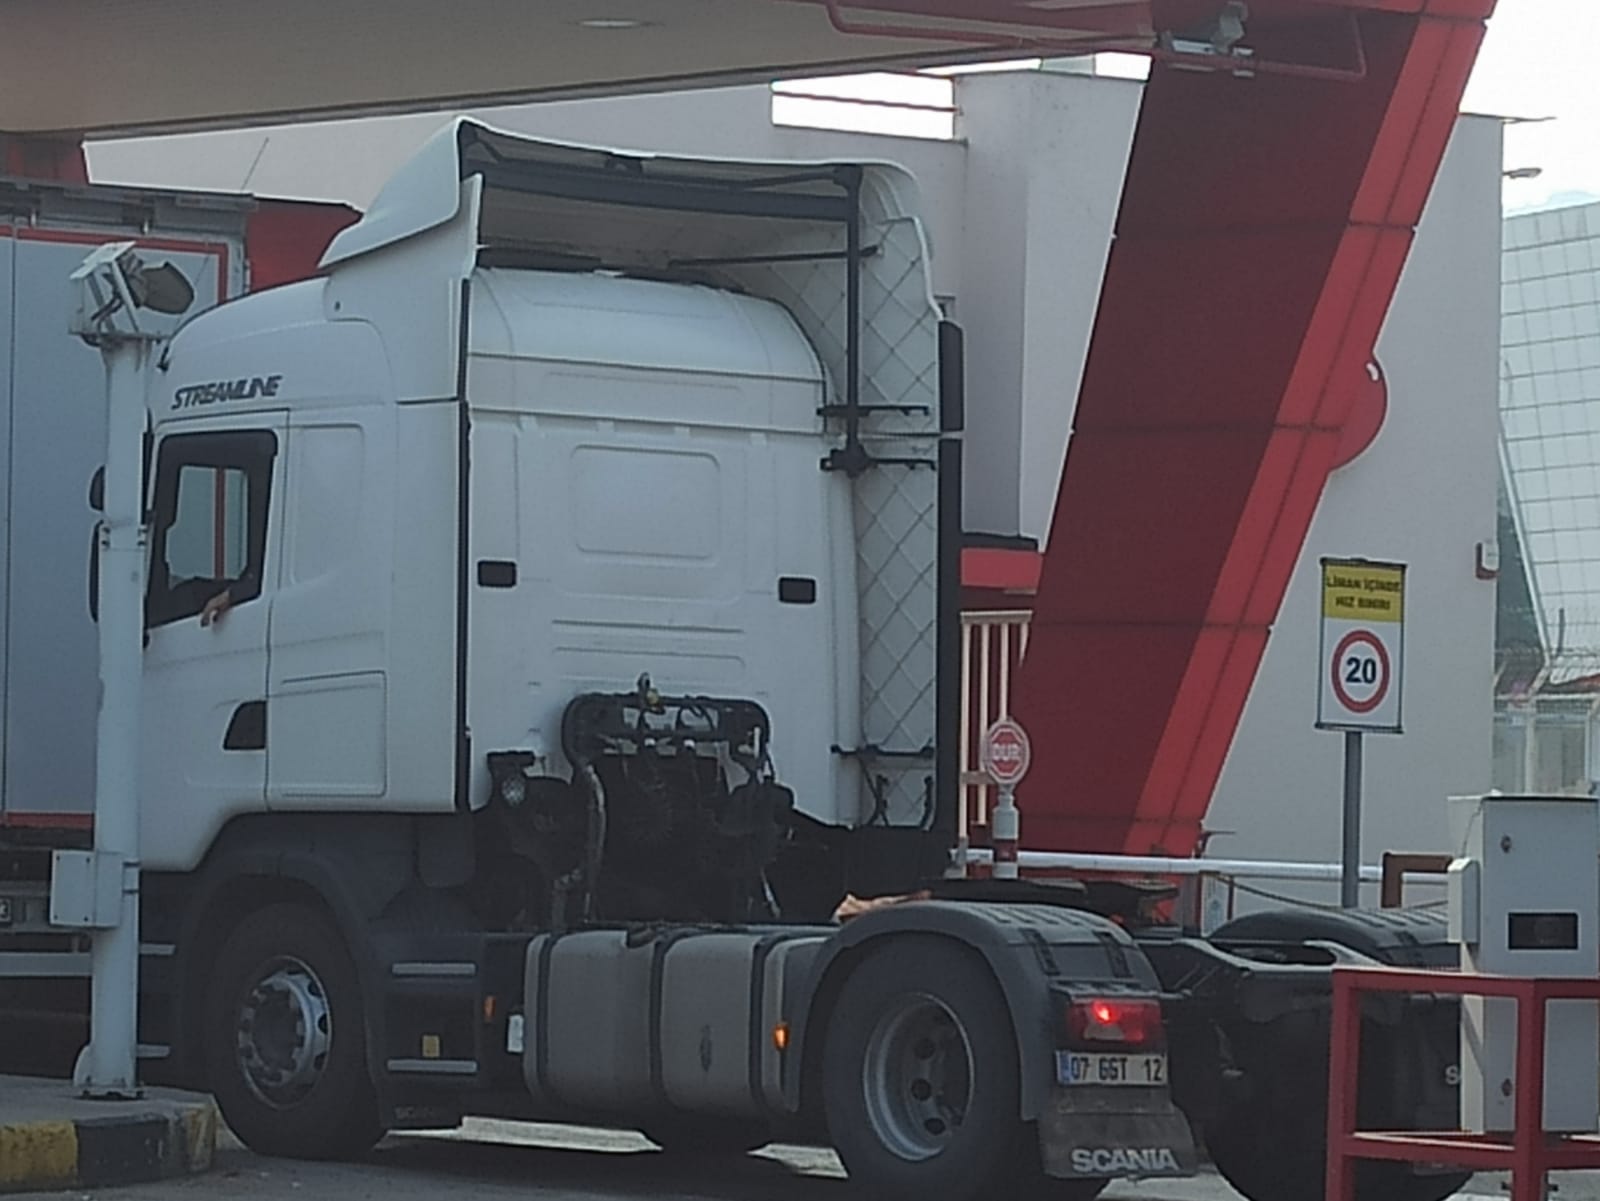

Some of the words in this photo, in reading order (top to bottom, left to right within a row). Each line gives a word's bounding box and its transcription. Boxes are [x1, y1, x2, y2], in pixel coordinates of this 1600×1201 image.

[171, 375, 283, 410] STREAMLINE
[1345, 657, 1377, 684] 20
[1071, 1056, 1090, 1081] 07
[1144, 1057, 1162, 1082] 12
[1071, 1148, 1180, 1172] SCANIA
